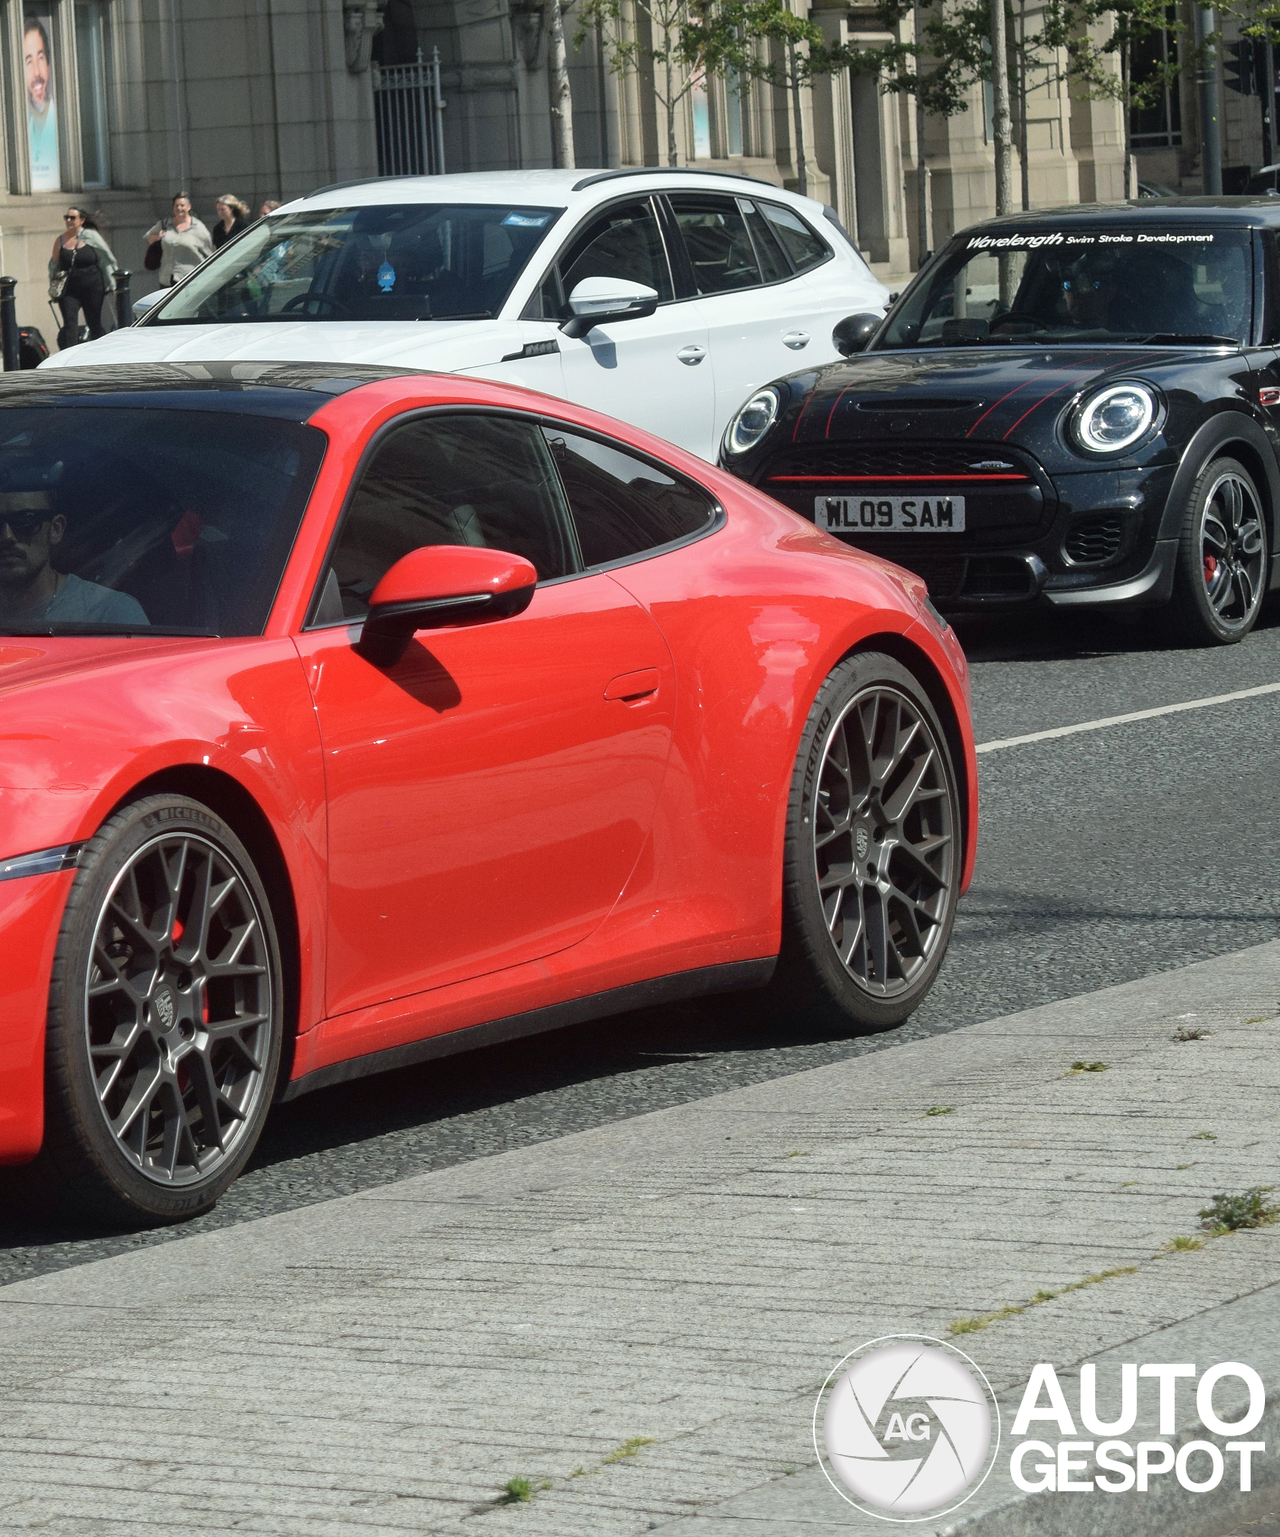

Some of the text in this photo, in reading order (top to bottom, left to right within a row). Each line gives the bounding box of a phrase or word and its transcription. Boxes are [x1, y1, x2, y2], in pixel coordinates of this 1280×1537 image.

[966, 232, 1214, 250] Wavelength Swim Stroke Development
[826, 500, 953, 527] WL09 SAM
[159, 807, 221, 833] MICHELIN
